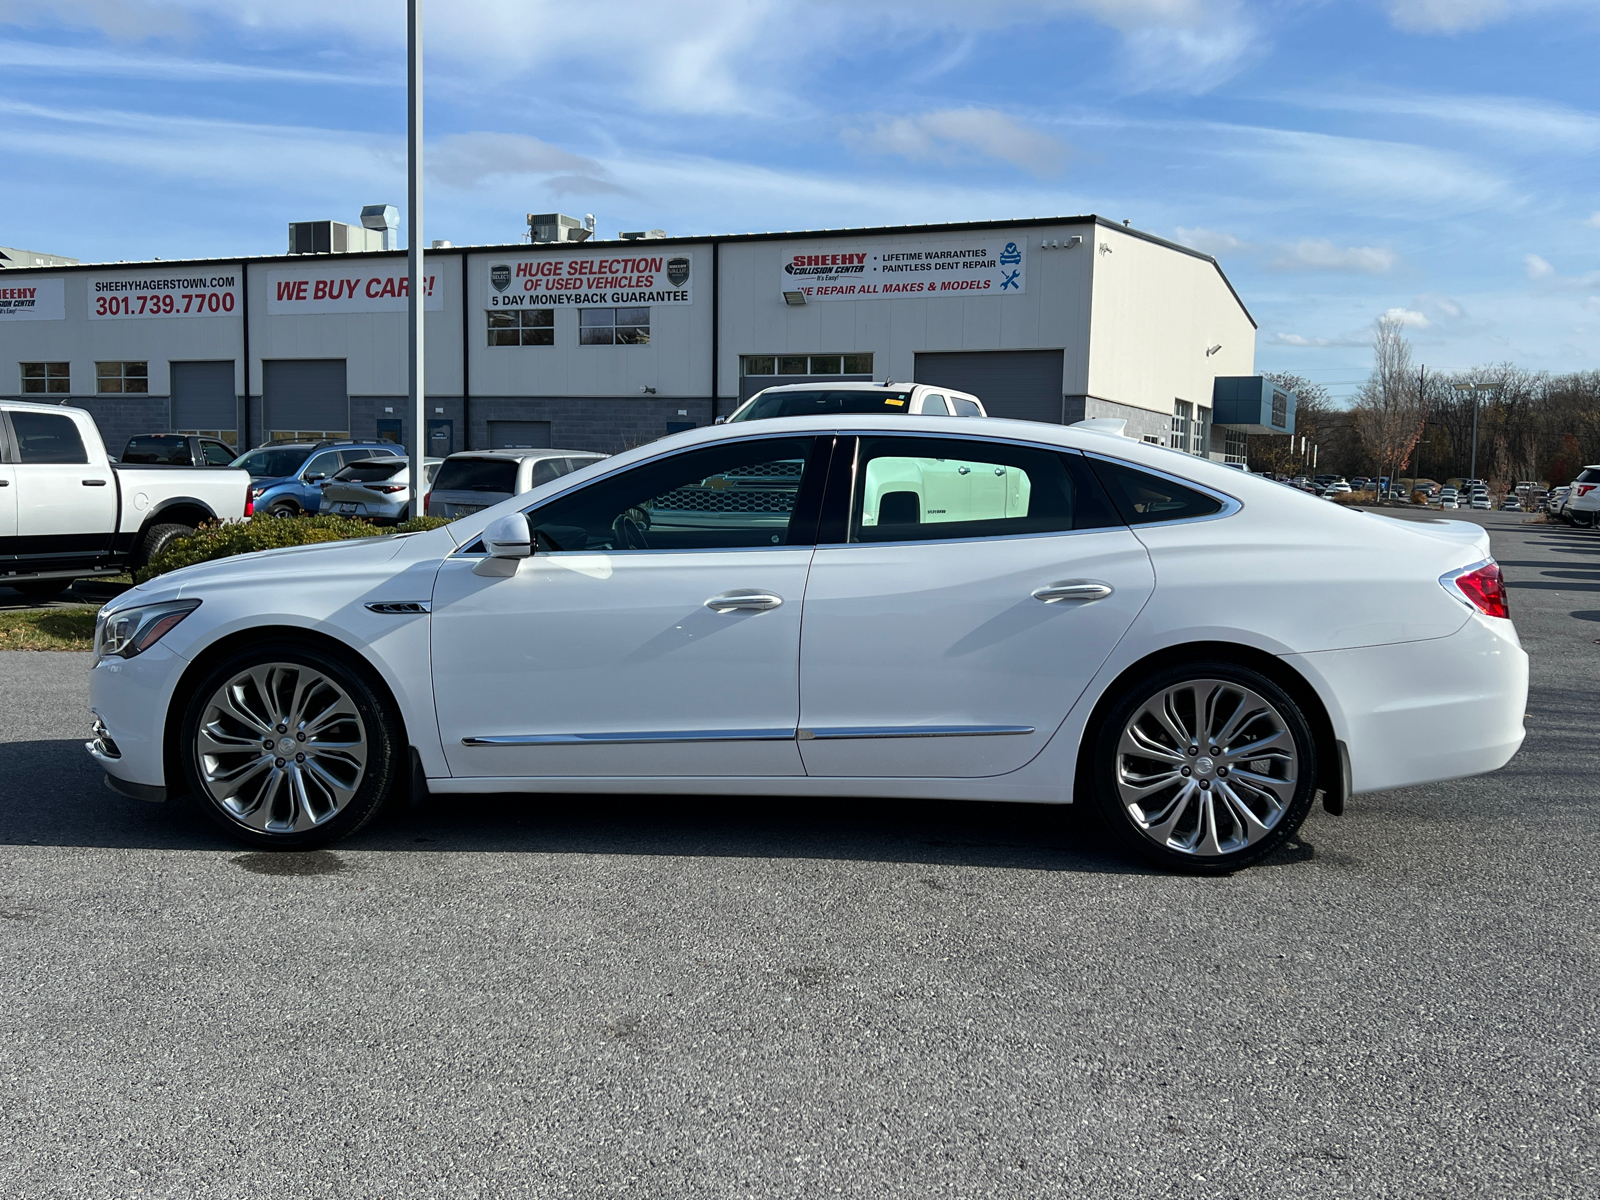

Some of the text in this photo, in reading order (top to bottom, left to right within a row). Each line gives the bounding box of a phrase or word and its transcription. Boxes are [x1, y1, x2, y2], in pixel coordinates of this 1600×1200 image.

[793, 252, 867, 267] SHEEHY
[882, 249, 987, 262] LIFETIME WARRANTIES
[515, 257, 663, 278] HUGE SELECTION
[793, 265, 865, 275] COLLISION CENTER
[882, 260, 996, 273] PAINTLESS DENT REPAIR
[95, 277, 235, 292] SHEEHYHAGERSTOWN.COM
[523, 274, 654, 292] OF USED VEHICLES
[825, 274, 839, 282] Easy!
[0, 288, 37, 299] EEHY
[277, 281, 309, 301] WE
[313, 279, 361, 300] BUY
[816, 285, 856, 296] REPAIR
[857, 284, 879, 294] ALL
[882, 282, 924, 293] MAKES
[927, 282, 937, 291] &
[940, 279, 991, 291] MODELS
[96, 292, 235, 316] 301.739.7700
[492, 290, 688, 306] 5 DAY MONEY-BACK GUARANTEE
